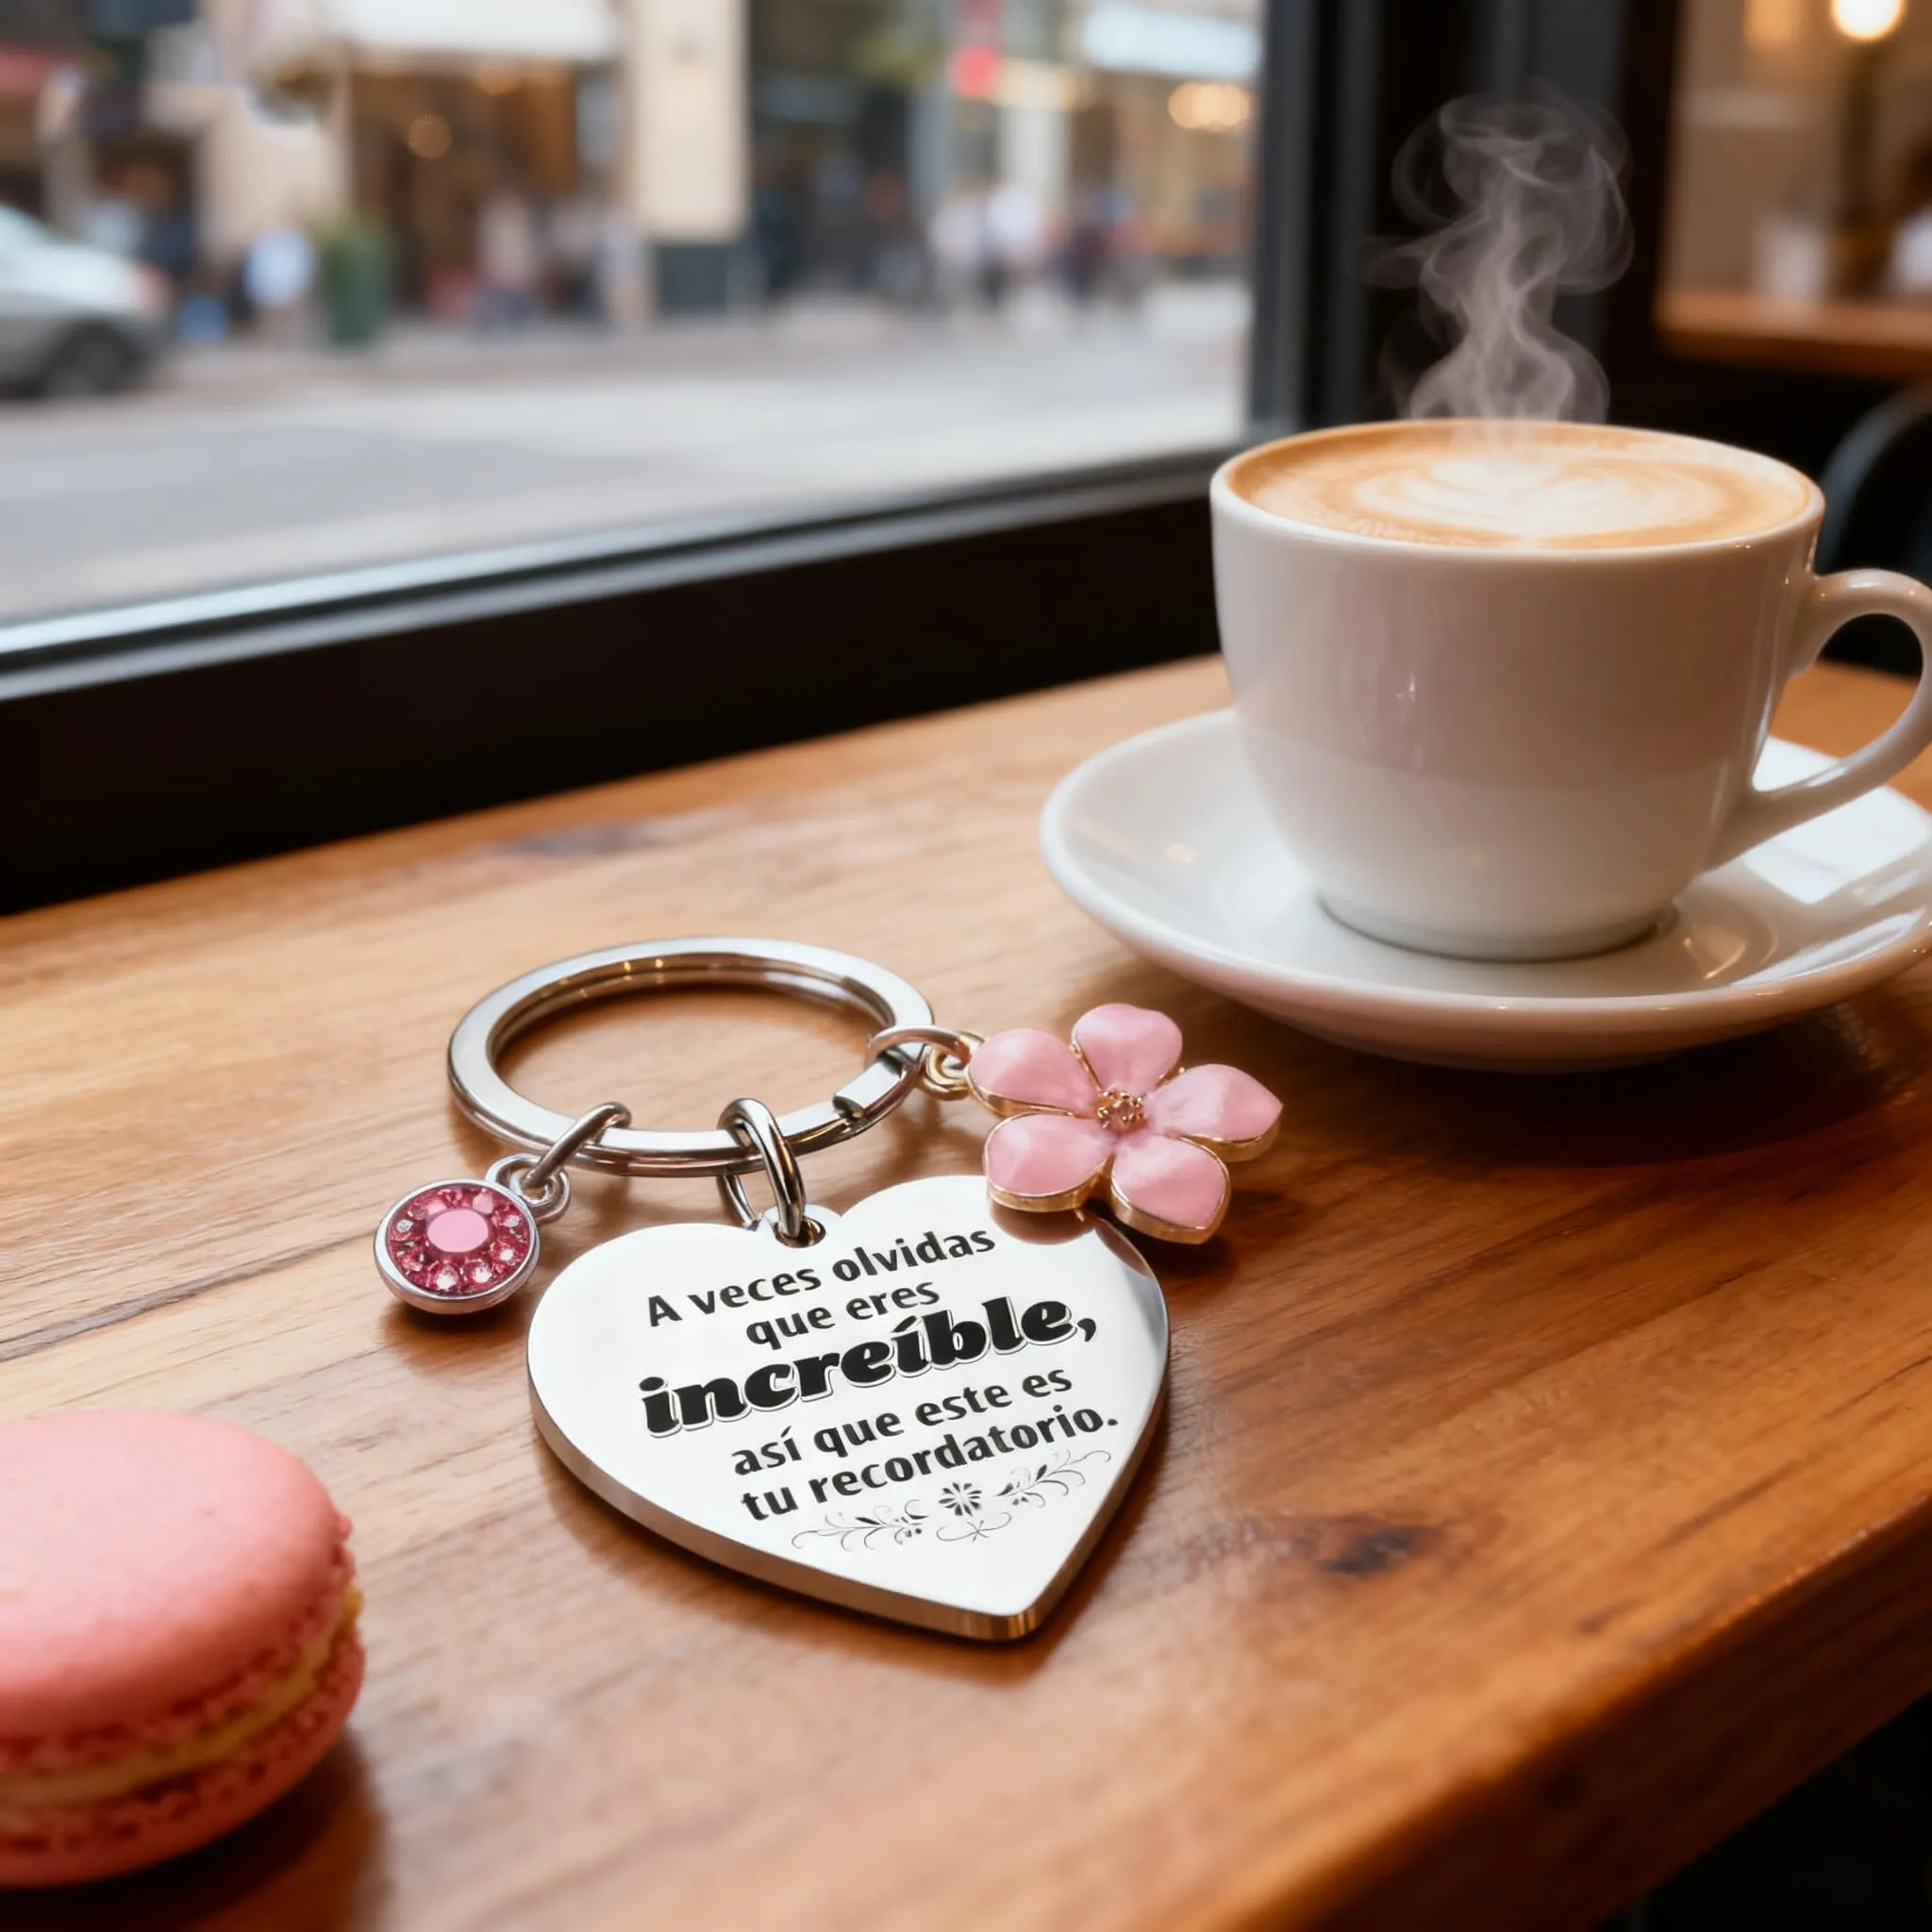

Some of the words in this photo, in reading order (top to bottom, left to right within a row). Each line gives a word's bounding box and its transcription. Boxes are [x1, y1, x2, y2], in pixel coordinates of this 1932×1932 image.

[648, 1295, 683, 1327] A
[688, 1269, 823, 1315] veces
[832, 1230, 995, 1282] olvidas
[745, 1307, 835, 1351] que
[845, 1282, 940, 1321] eres
[639, 1296, 1098, 1438] increíble,
[731, 1425, 802, 1475] así
[813, 1412, 904, 1458] que
[915, 1385, 1012, 1427] este
[1022, 1369, 1073, 1398] es
[741, 1487, 798, 1521] tu
[808, 1405, 1118, 1504] recordatorio.
